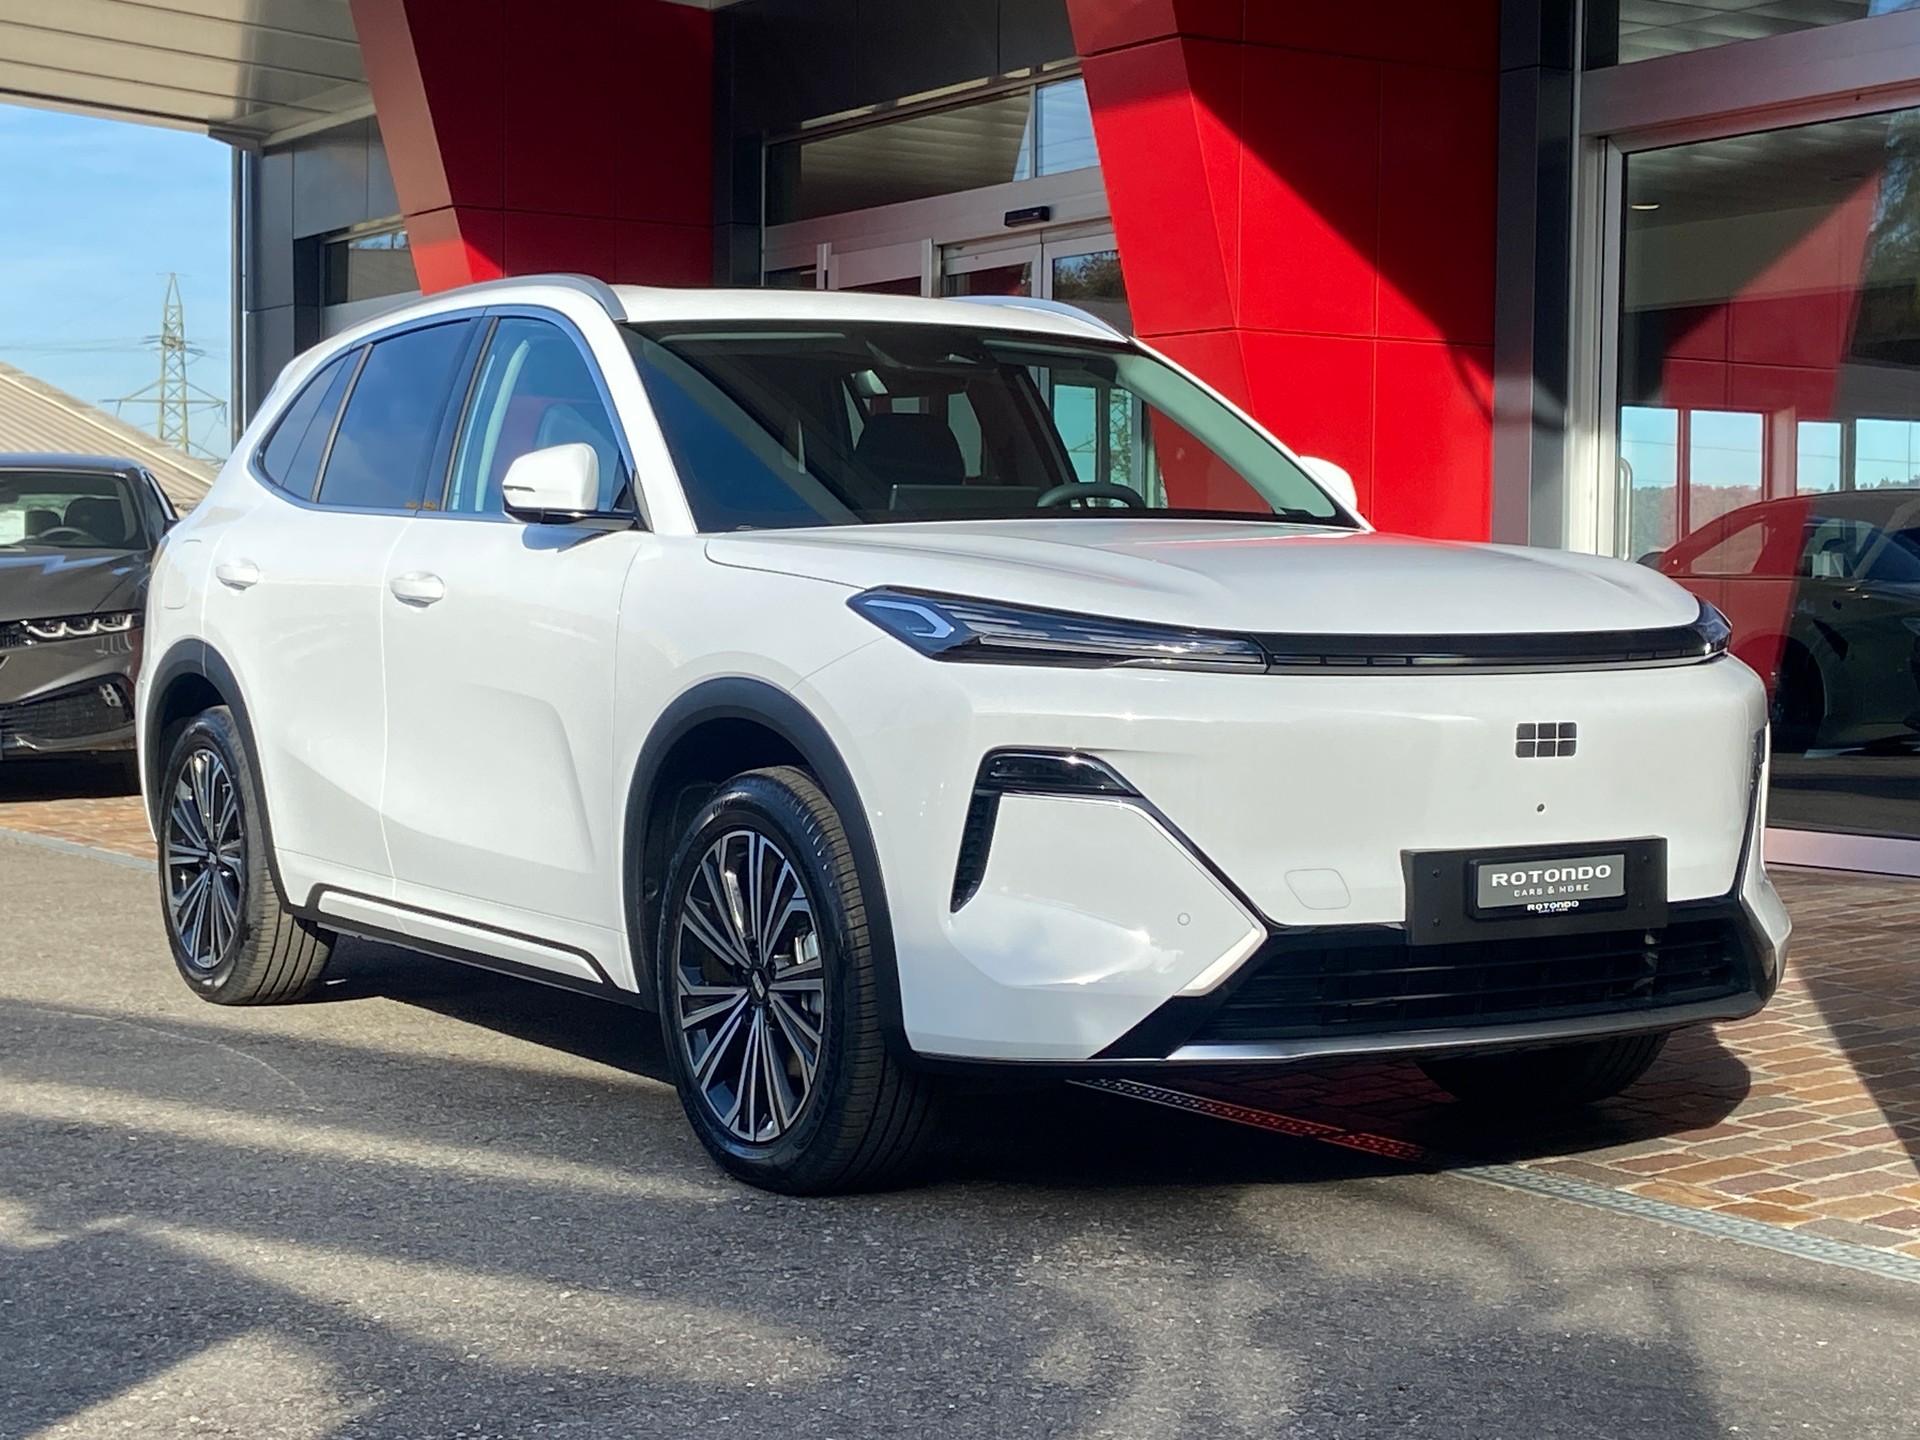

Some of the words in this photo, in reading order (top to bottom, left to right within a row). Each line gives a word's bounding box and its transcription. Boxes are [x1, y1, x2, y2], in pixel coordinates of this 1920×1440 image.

[1491, 865, 1612, 887] ROTONDO
[1513, 888, 1543, 897] CARS
[1547, 886, 1555, 894] &
[1527, 900, 1579, 911] ROTONDO
